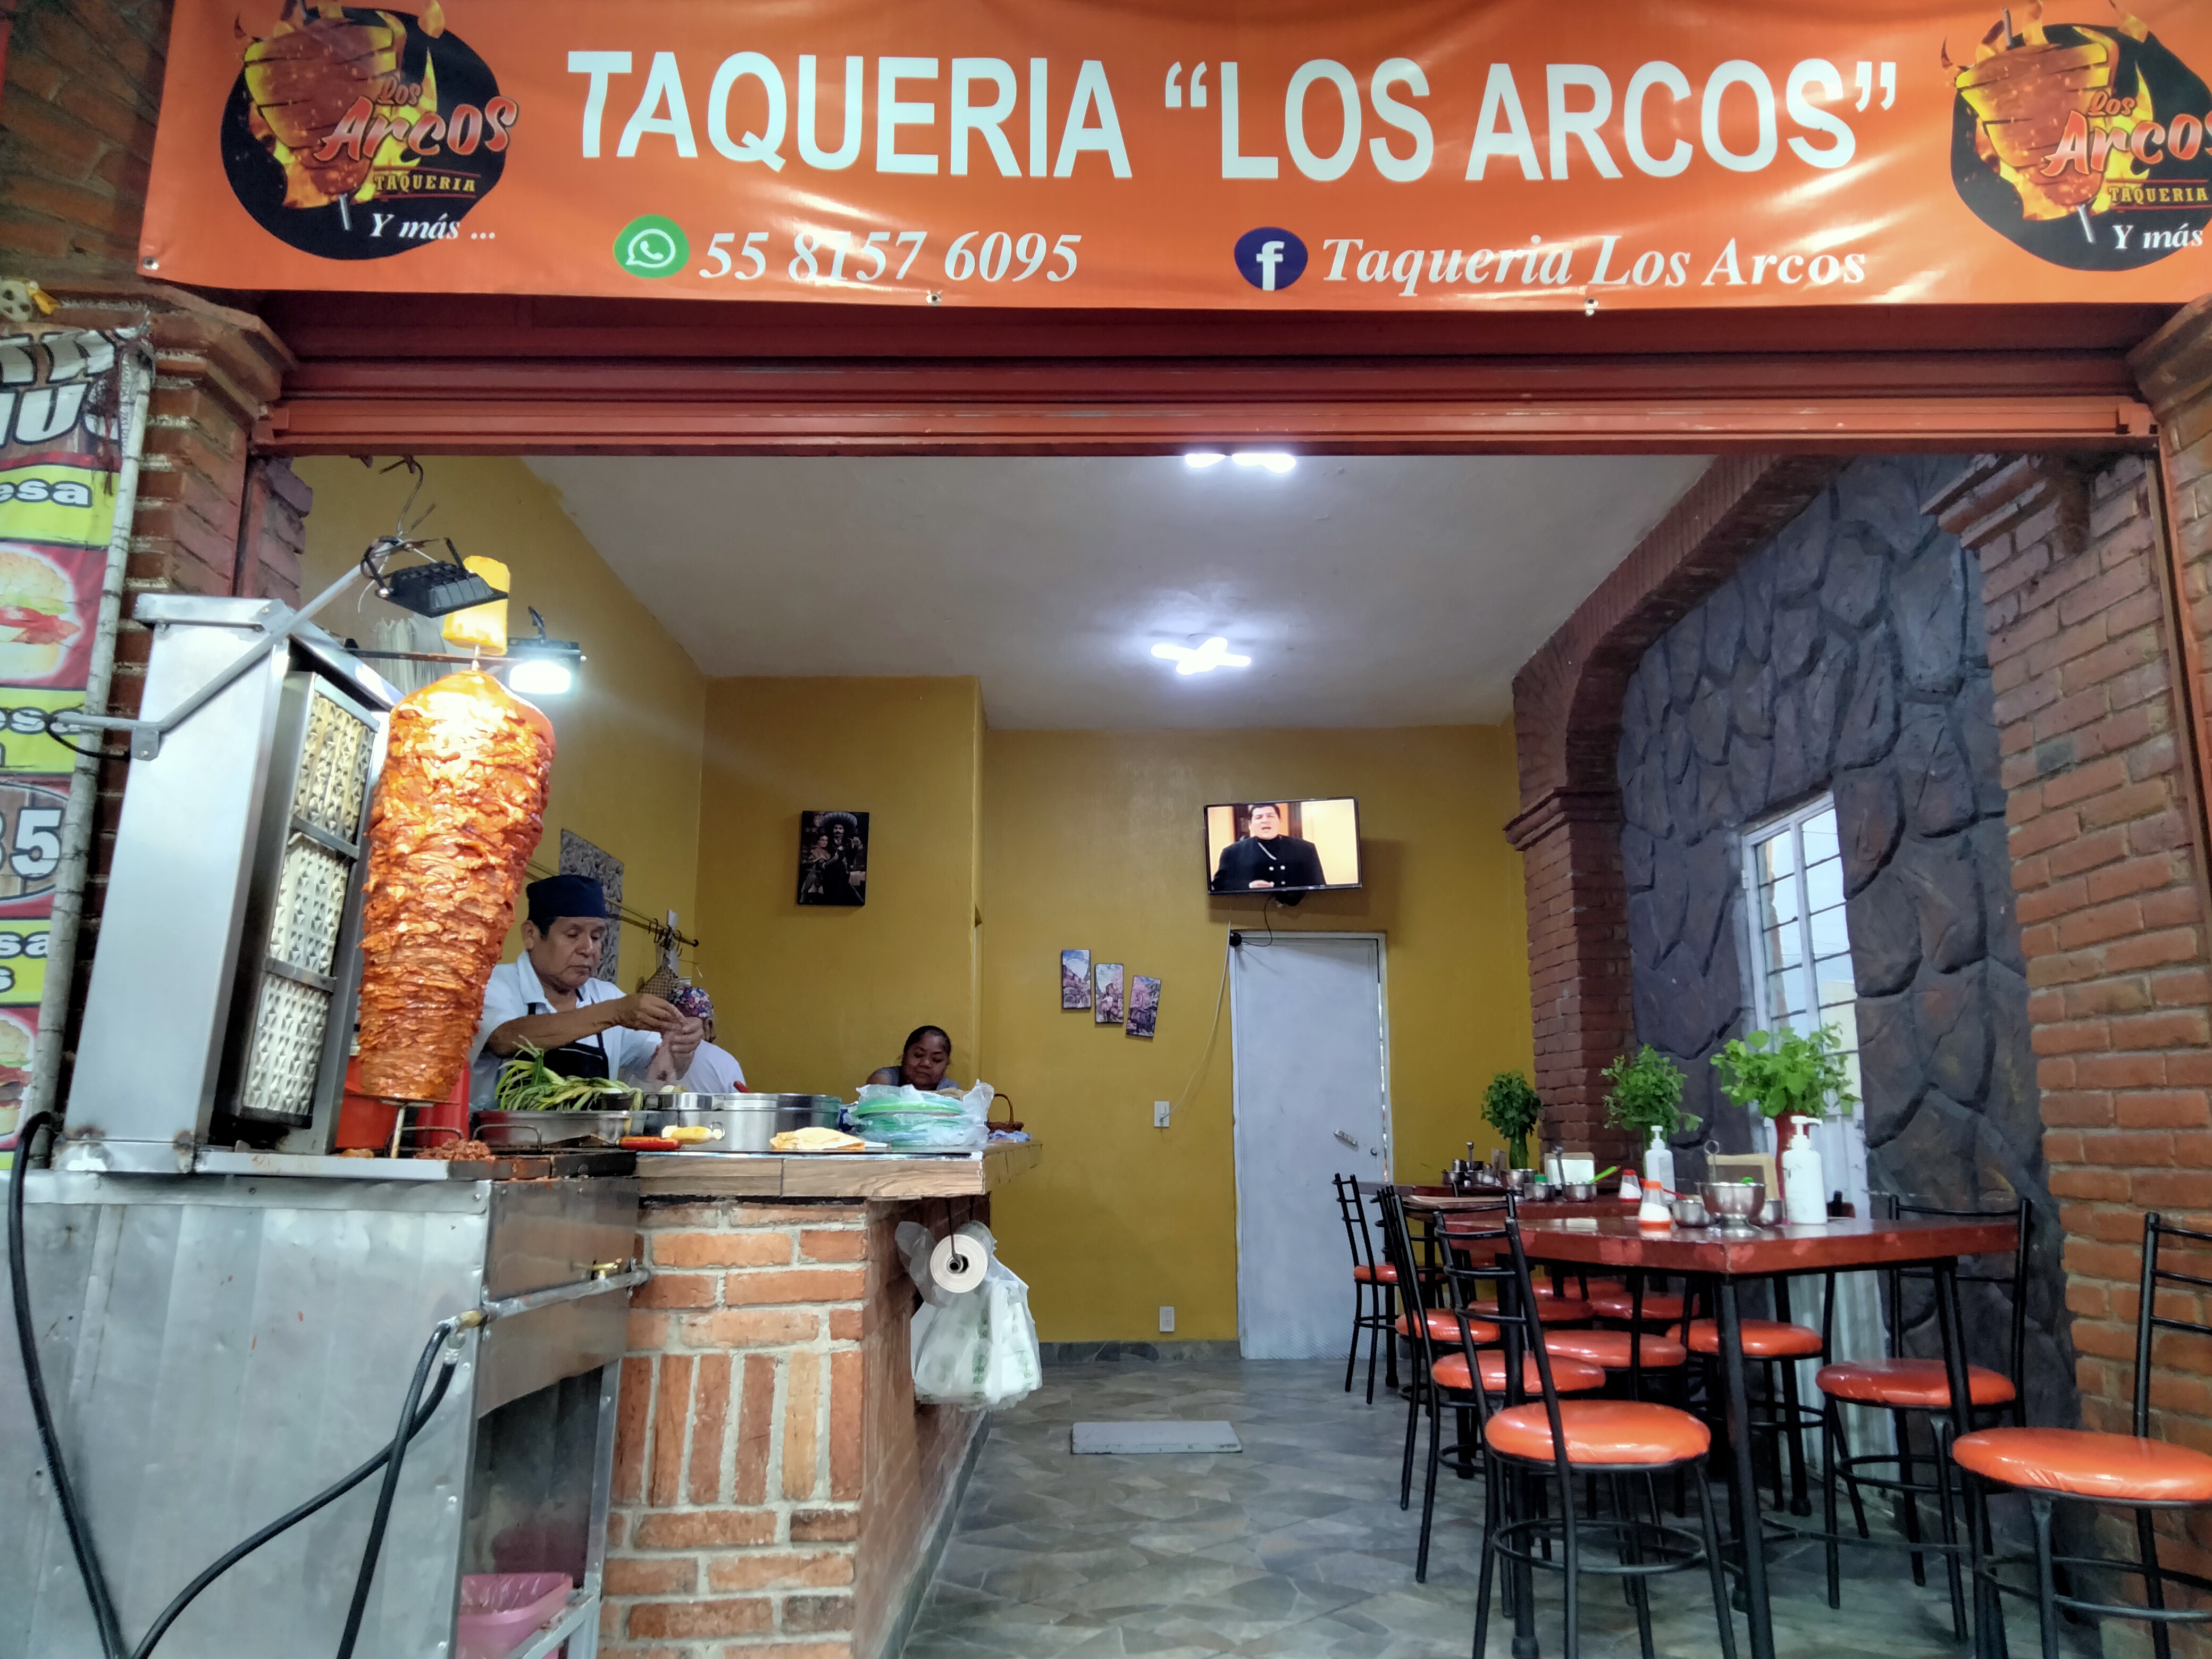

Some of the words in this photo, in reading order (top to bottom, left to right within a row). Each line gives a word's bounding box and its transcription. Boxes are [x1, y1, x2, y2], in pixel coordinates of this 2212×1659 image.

[568, 51, 1132, 178] TAQUERIA
[375, 175, 475, 192] TAQUERIA
[2108, 187, 2208, 203] TAQUERIA
[371, 213, 394, 237] Y
[2112, 224, 2134, 249] Y
[2142, 223, 2203, 249] más
[699, 232, 769, 280] 55
[788, 231, 927, 281] 8157
[944, 231, 1082, 282] 6095
[1322, 235, 1572, 296] Taqueria
[1587, 235, 1691, 287] Los
[1702, 237, 1865, 286] Arcos
